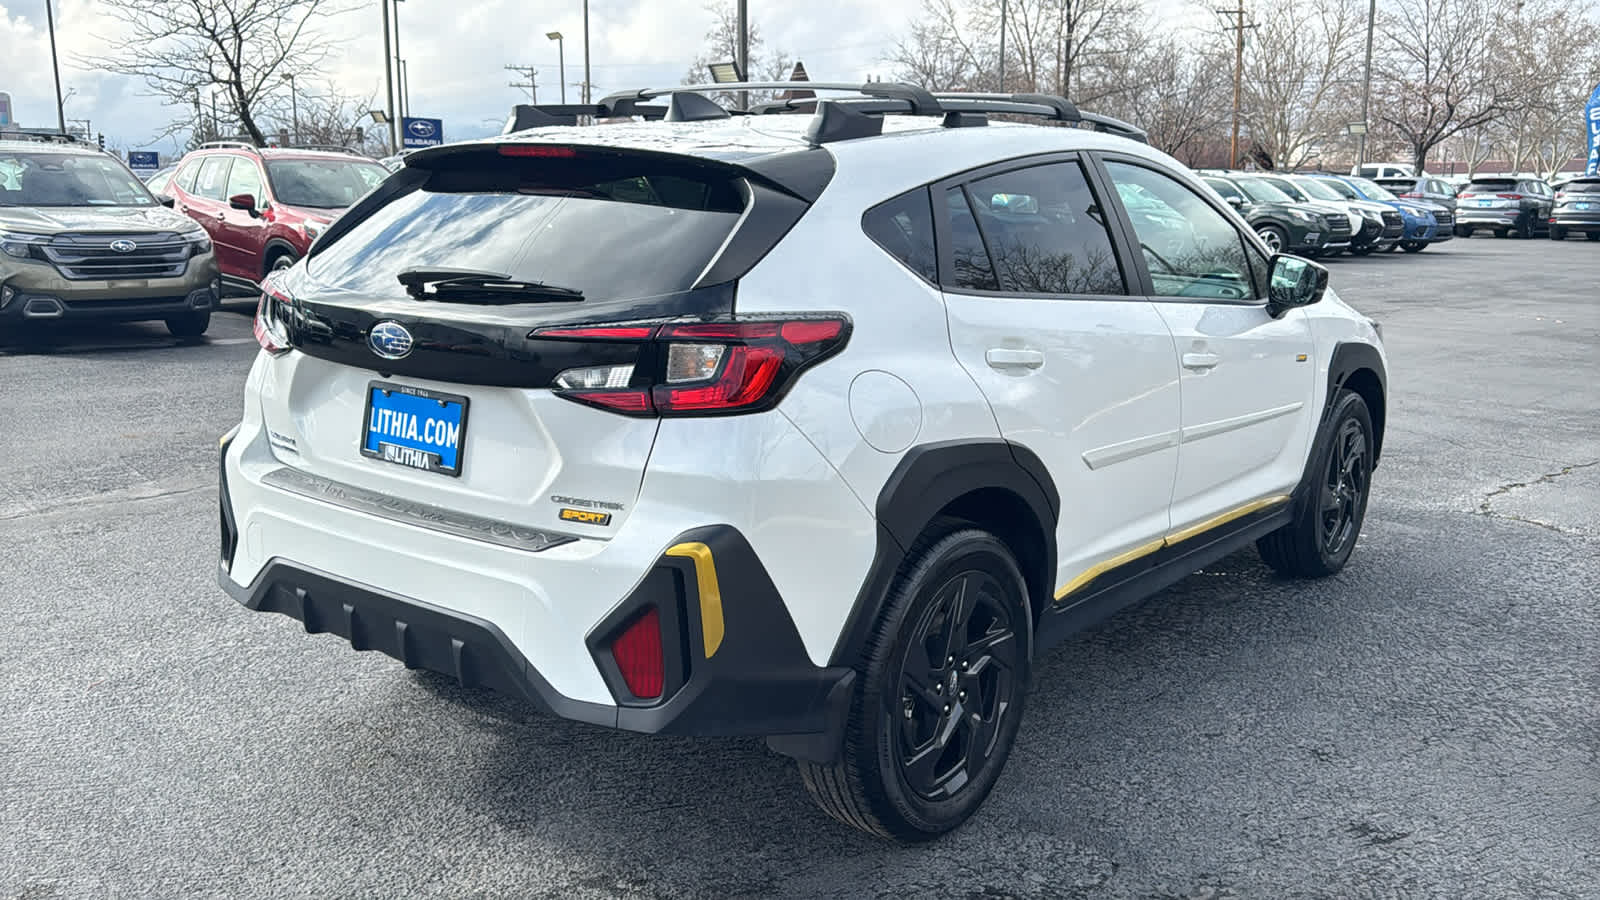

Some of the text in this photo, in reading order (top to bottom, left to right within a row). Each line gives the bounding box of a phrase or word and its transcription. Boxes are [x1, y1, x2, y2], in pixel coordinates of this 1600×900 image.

[404, 138, 441, 146] SUBARU
[400, 386, 416, 396] SINCE
[369, 406, 460, 449] LITHIA.COM
[395, 447, 430, 470] LITHIA
[551, 495, 625, 511] CROSSTREK
[561, 509, 605, 523] SPORT
